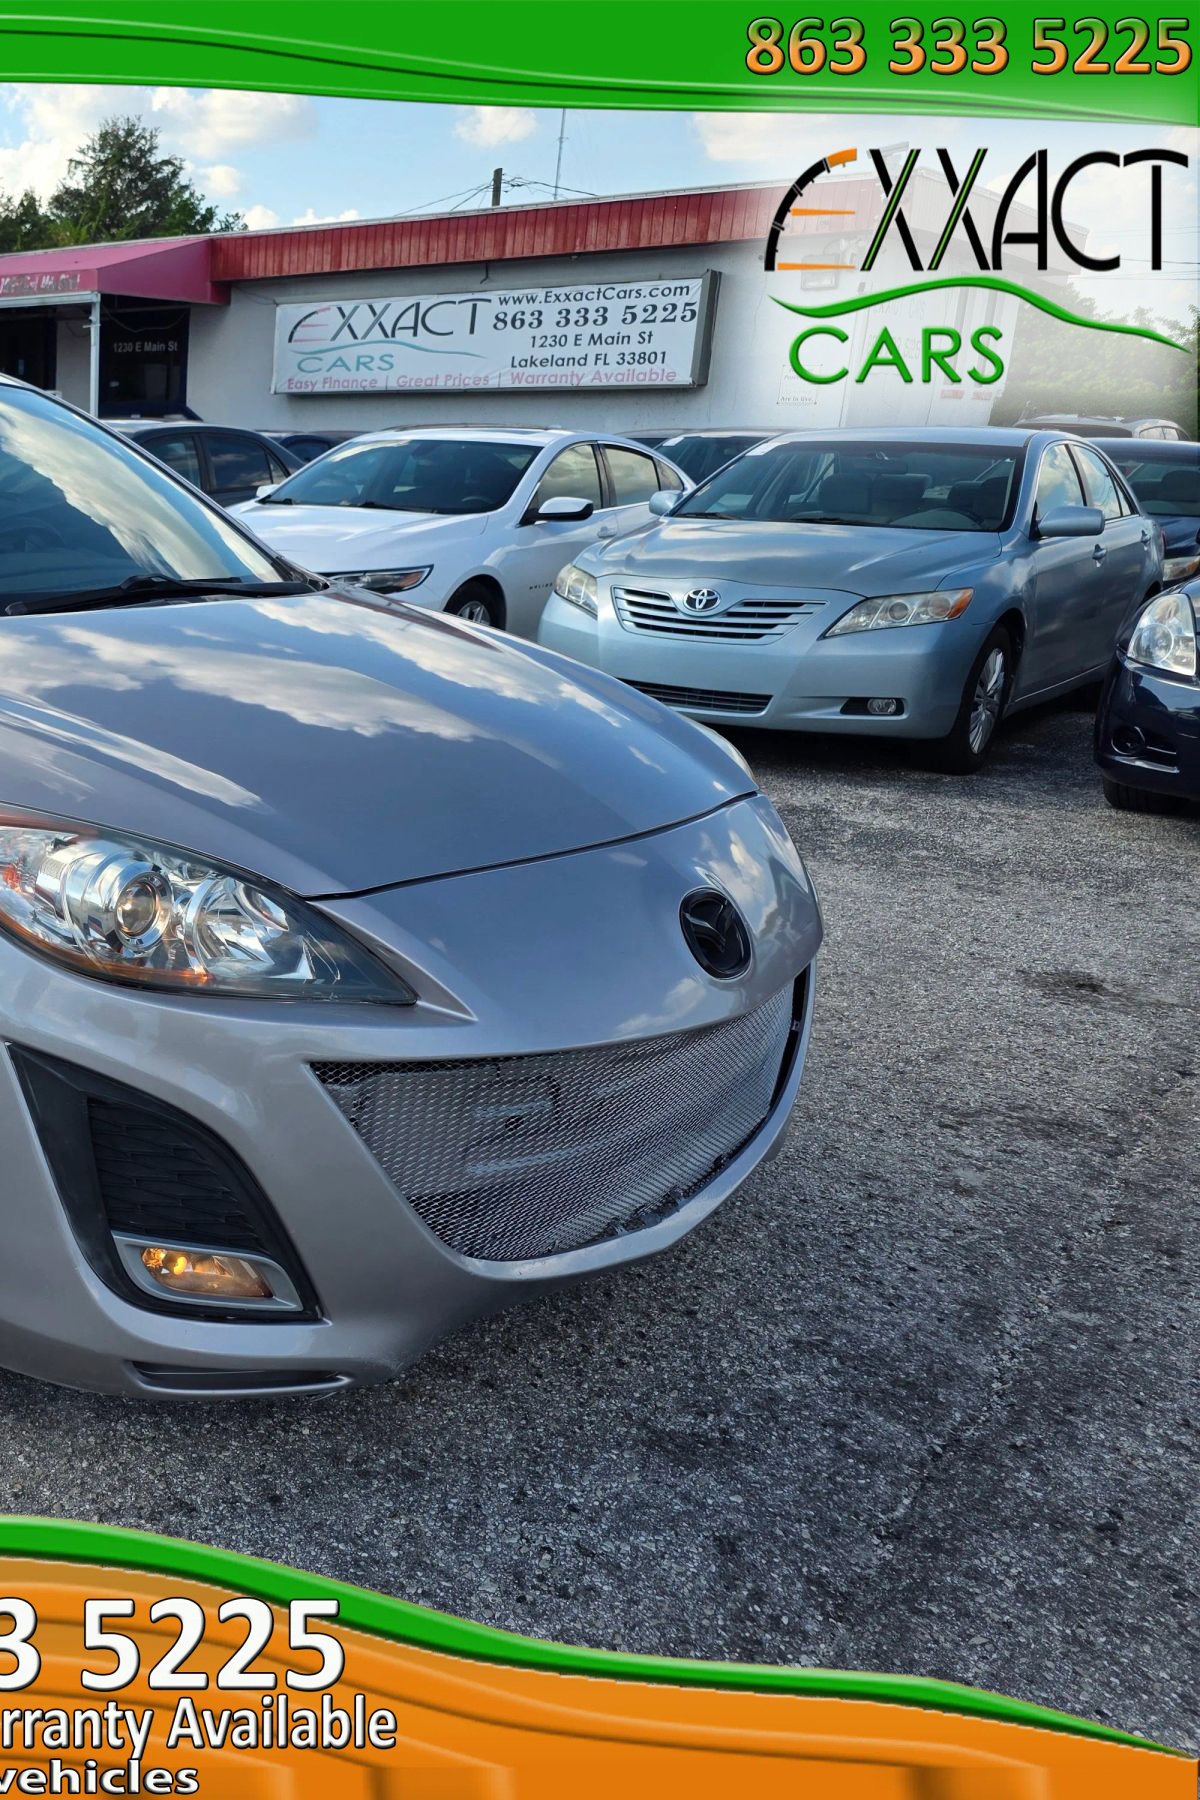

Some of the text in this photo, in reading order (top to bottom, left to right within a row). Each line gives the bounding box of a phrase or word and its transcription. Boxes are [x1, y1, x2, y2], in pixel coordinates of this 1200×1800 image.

[498, 284, 690, 306] www.ExxactCars.com
[288, 298, 492, 343] EXXACT
[492, 301, 698, 331] 863 333 5225
[113, 340, 178, 352] 1230 E Main St
[530, 330, 653, 348] 1230 E Main St
[297, 353, 395, 374] CARS
[510, 351, 667, 369] Lakeland FL 33801
[287, 376, 378, 392] Easy Finance
[396, 373, 490, 388] Great Prices
[510, 368, 677, 387] Warranty Available
